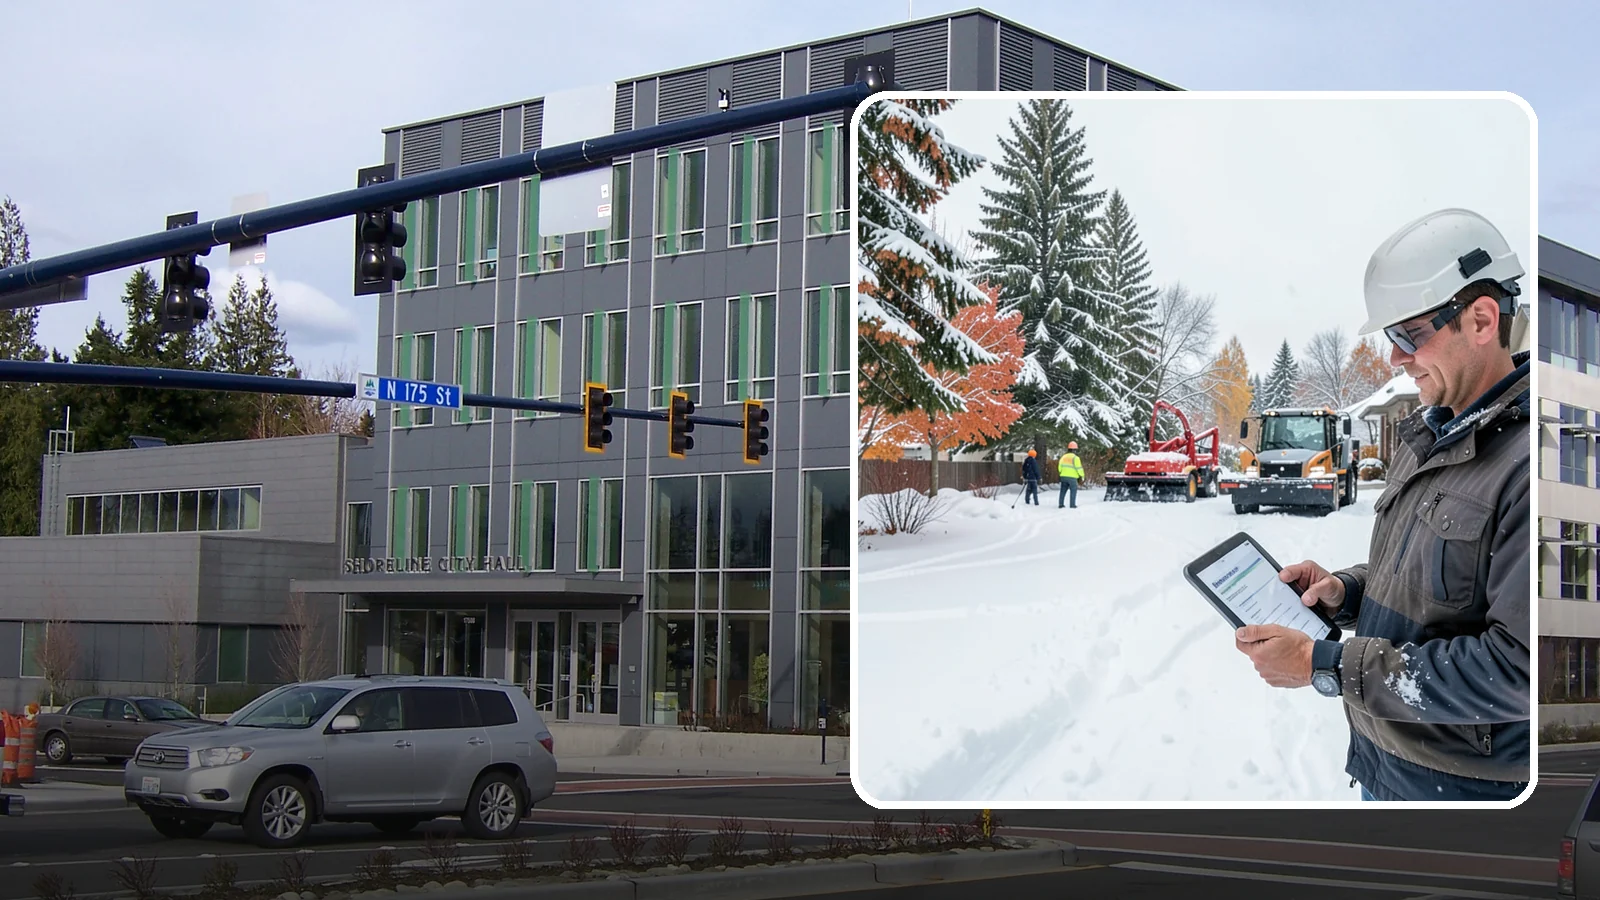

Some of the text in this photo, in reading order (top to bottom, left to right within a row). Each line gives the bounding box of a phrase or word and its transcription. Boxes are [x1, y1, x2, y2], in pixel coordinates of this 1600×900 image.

[387, 380, 451, 406] N 175 St
[344, 555, 526, 574] SHORELINE CITY HALL
